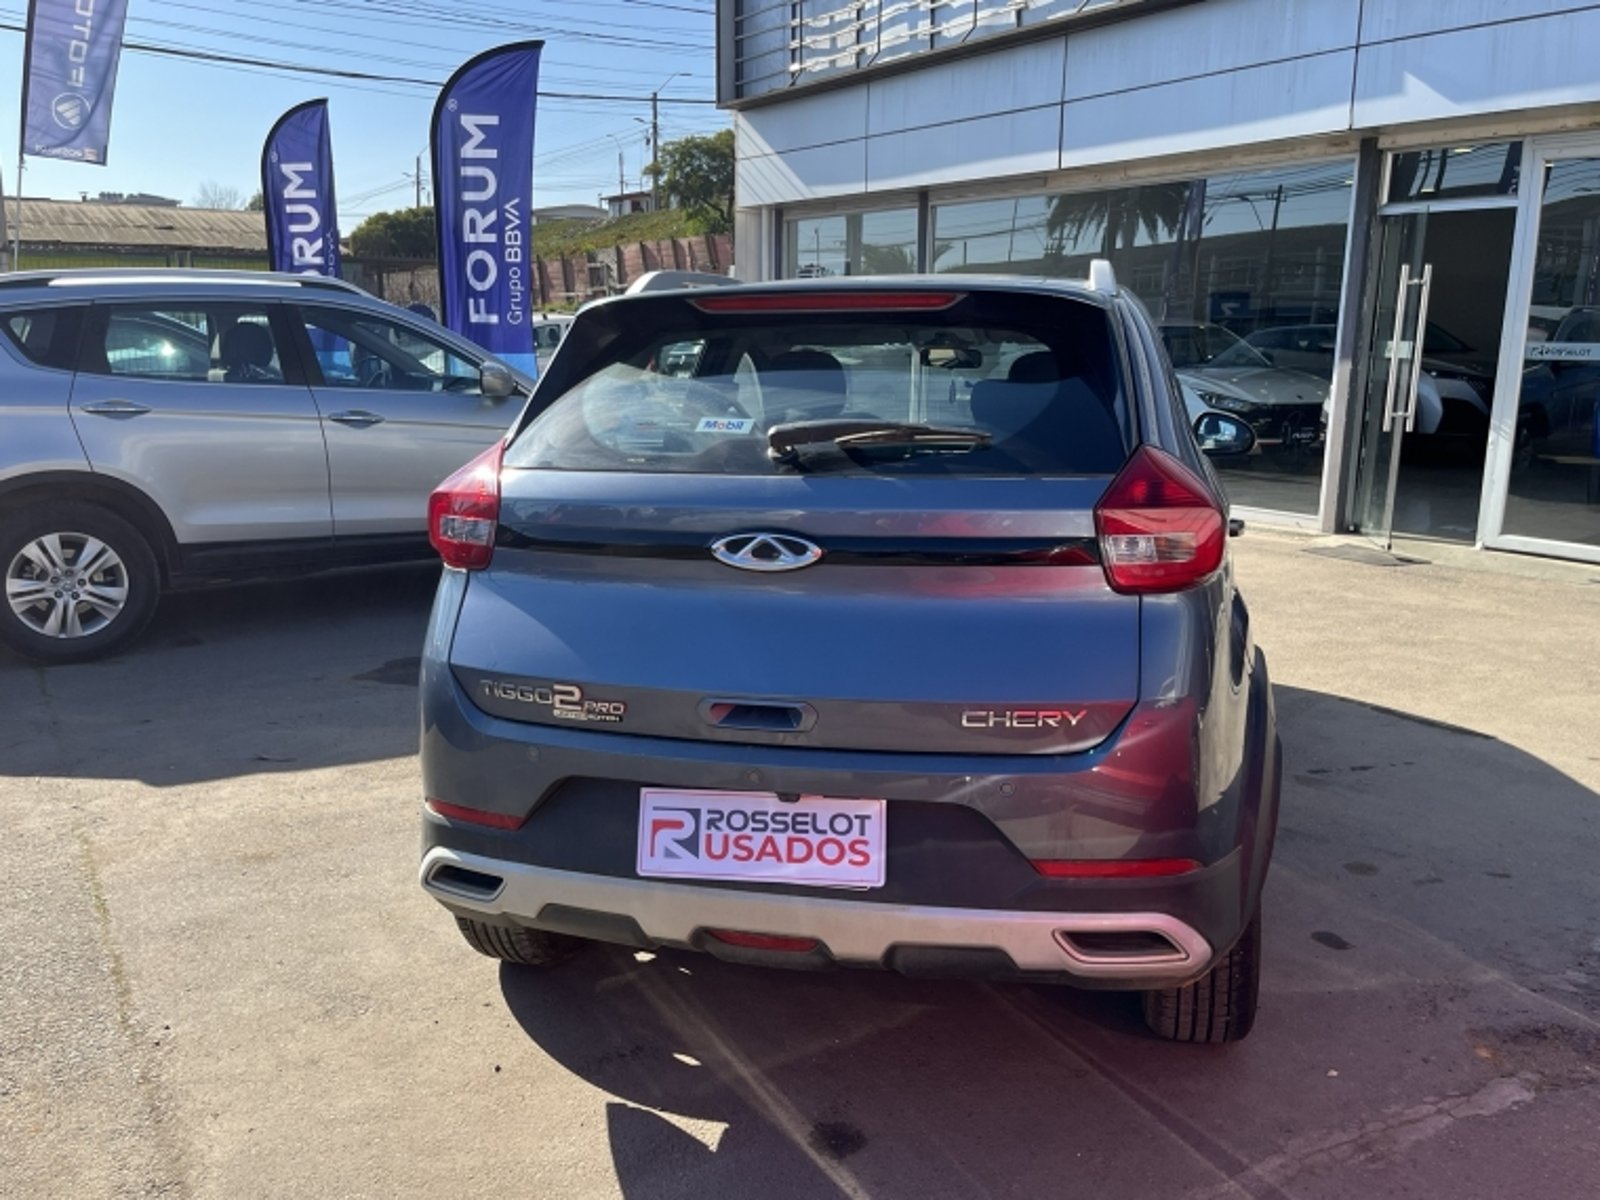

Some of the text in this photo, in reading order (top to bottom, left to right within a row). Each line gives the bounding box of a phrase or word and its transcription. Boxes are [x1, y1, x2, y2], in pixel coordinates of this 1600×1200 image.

[280, 162, 325, 276] RUM
[460, 114, 500, 325] FORUM
[504, 197, 525, 326] Grupo BBVA
[704, 420, 744, 431] Mobil
[553, 683, 582, 711] 2
[583, 702, 625, 715] PRO
[961, 709, 1088, 728] CHERY
[706, 809, 872, 837] ROSSELOT
[705, 833, 872, 868] USADOS
